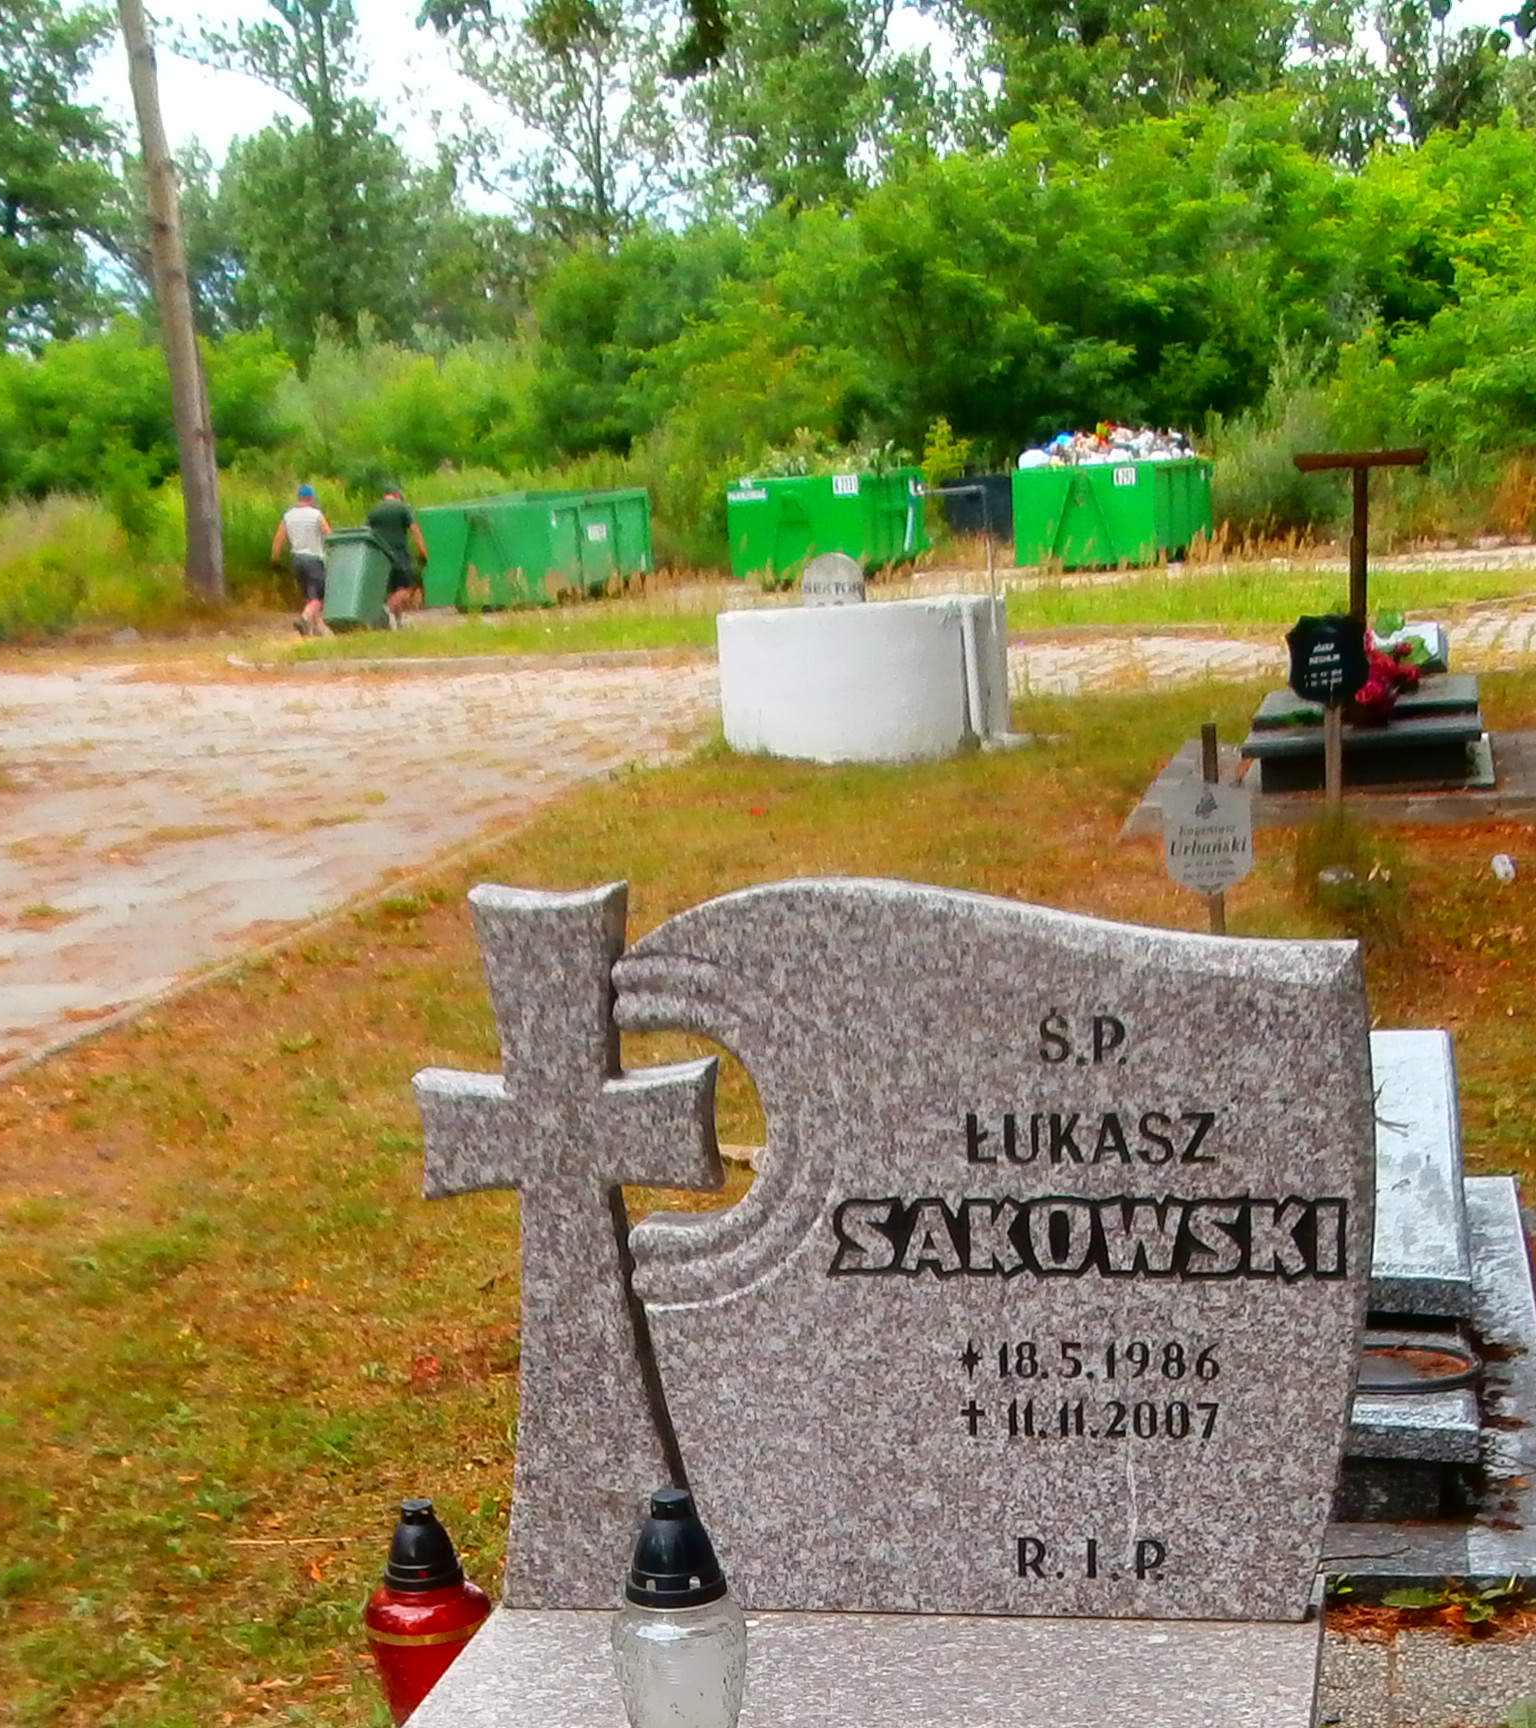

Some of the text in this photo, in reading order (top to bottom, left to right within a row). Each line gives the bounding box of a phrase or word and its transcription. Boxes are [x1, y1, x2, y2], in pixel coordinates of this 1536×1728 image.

[1170, 836, 1248, 856] Urbański
[965, 1110, 1217, 1165] ŁUKASZ
[827, 1194, 1349, 1282] SAKOWSKI
